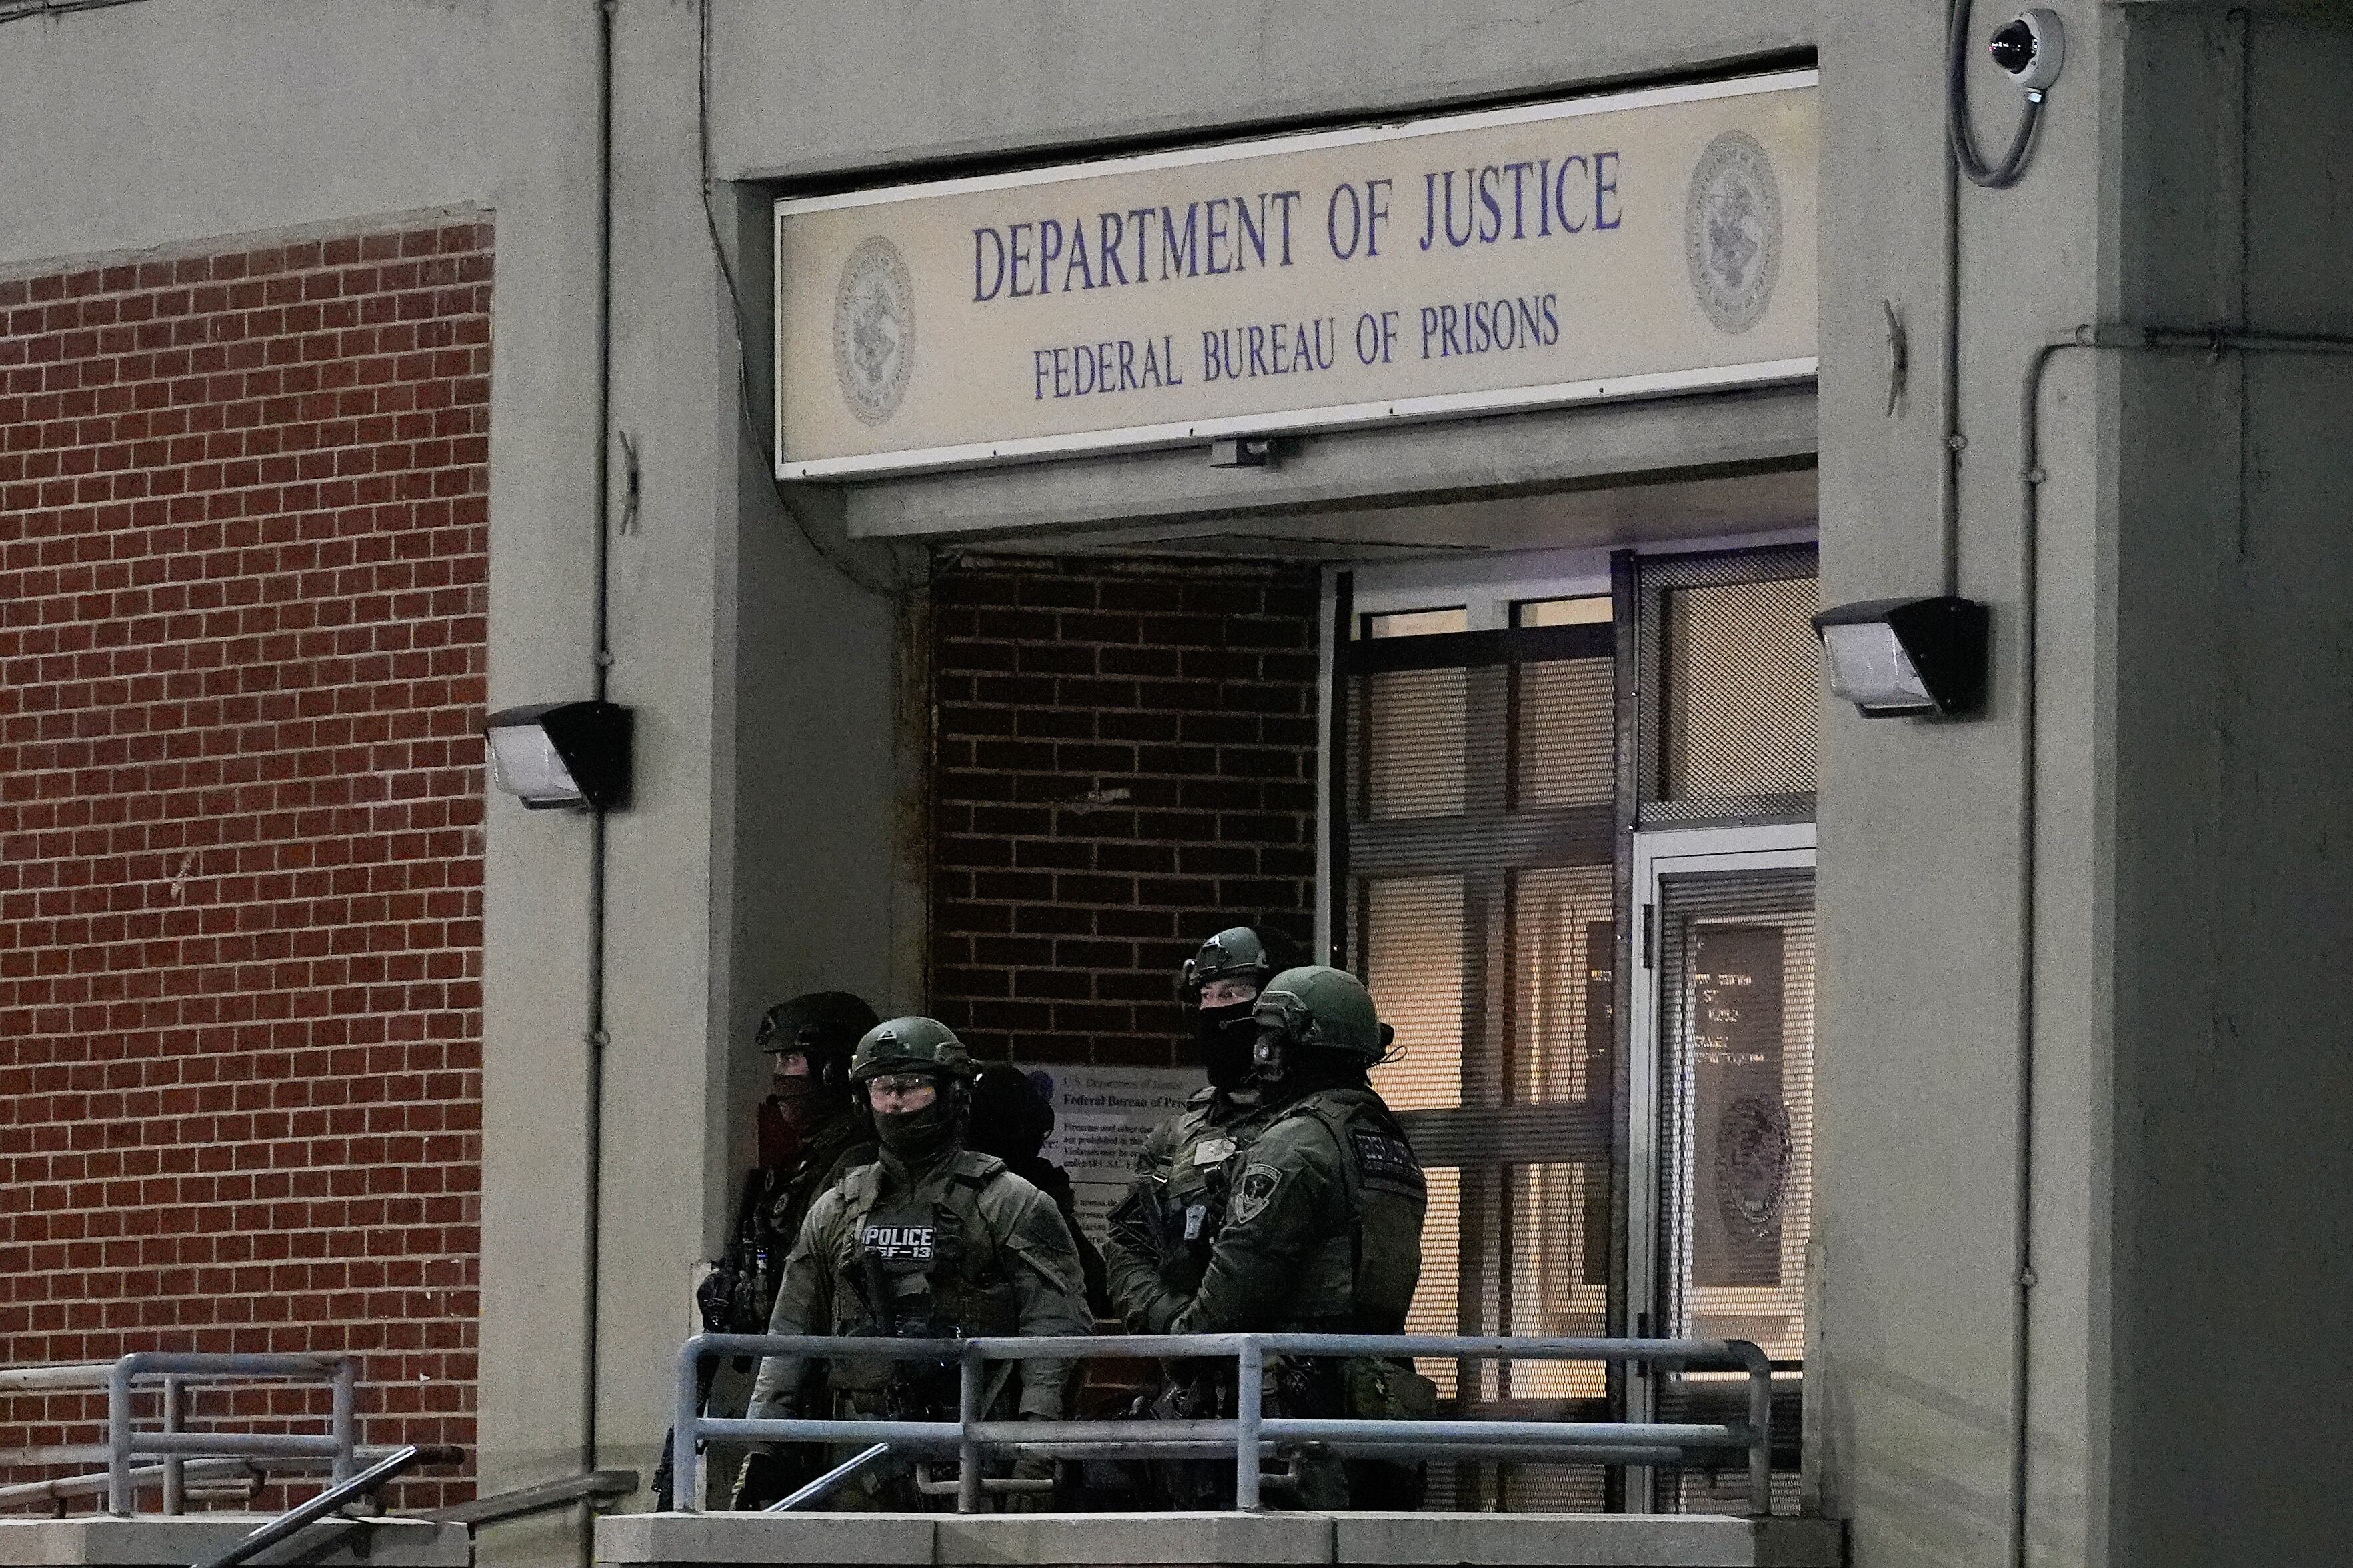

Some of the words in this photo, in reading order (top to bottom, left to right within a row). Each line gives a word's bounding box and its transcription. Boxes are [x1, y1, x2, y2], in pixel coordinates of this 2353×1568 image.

[973, 190, 1301, 302] DEPARTMENT
[1327, 178, 1393, 261] OF
[1419, 151, 1622, 252] JUSTICE
[1033, 335, 1183, 401] FEDERAL
[1202, 319, 1334, 382] BUREAU
[1356, 311, 1400, 365] OF
[1420, 293, 1560, 360] PRISONS
[1063, 1094, 1105, 1106] Federal
[1108, 1095, 1147, 1107] Bureau
[1150, 1097, 1163, 1108] of
[1164, 1097, 1187, 1109] Pris
[865, 1228, 933, 1246] POLICE
